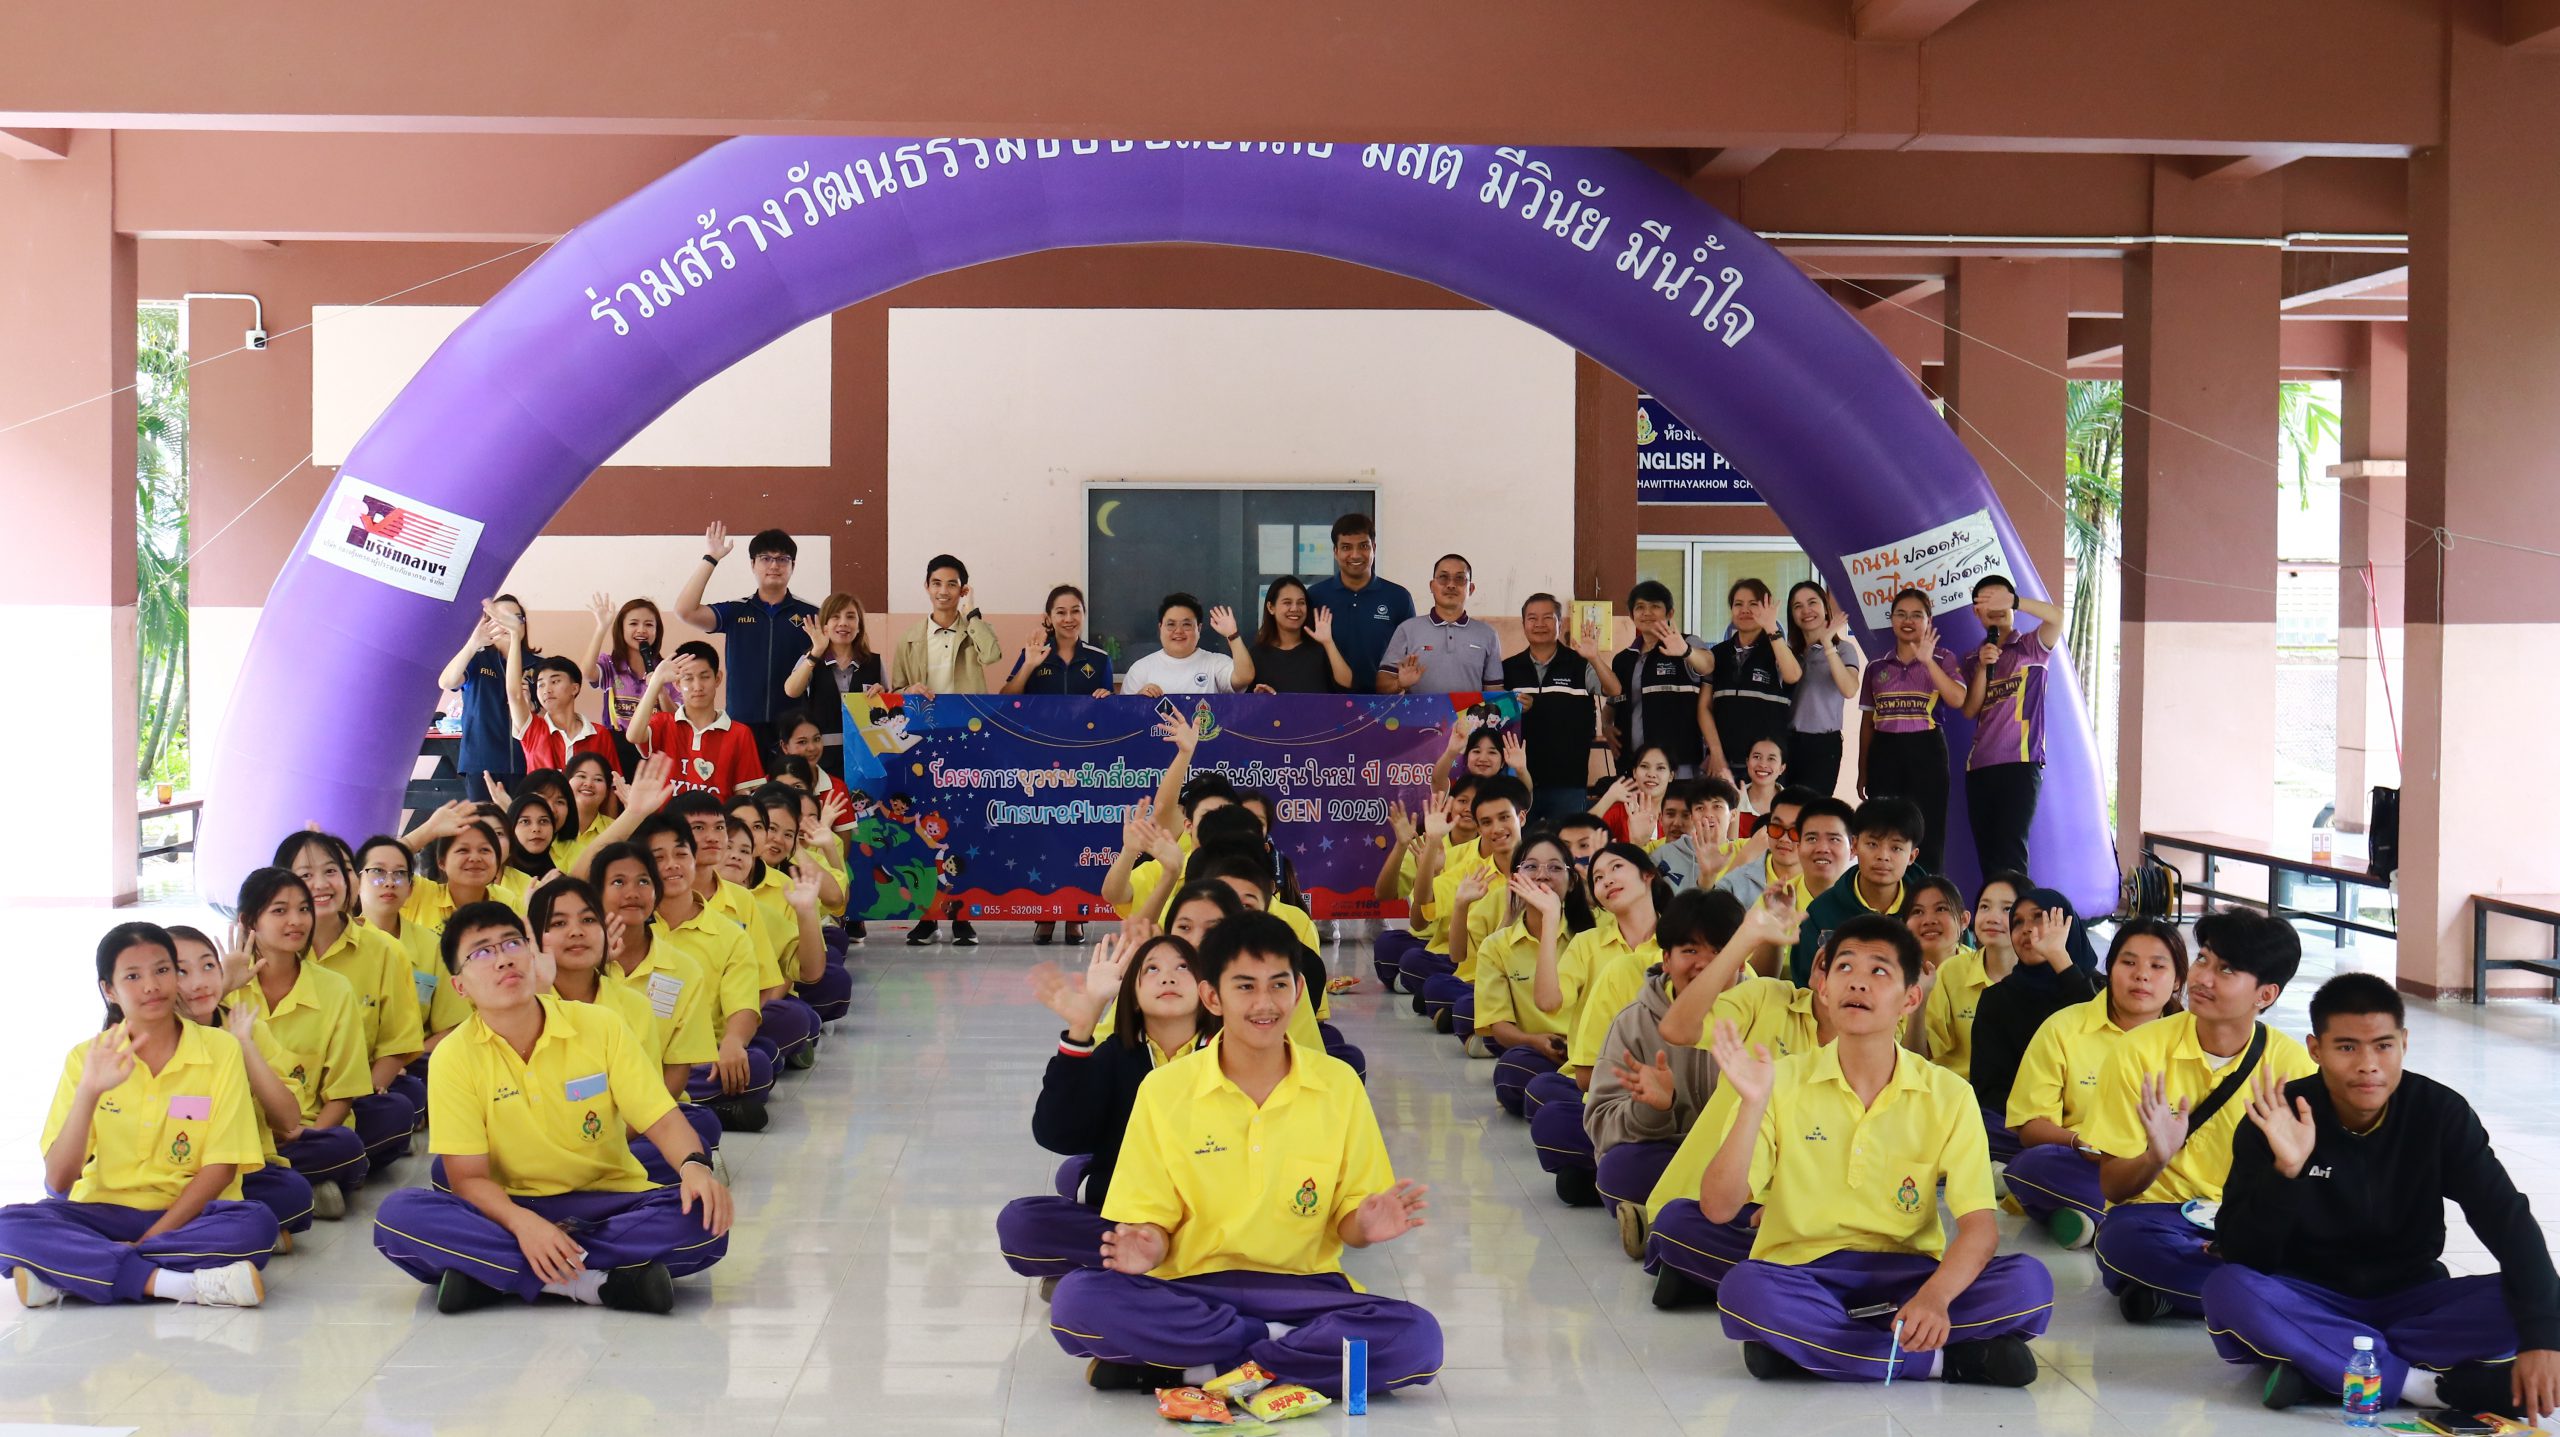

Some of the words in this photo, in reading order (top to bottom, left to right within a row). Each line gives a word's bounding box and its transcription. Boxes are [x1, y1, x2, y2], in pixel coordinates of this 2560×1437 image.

[1479, 146, 1611, 252] มีวินัย
[1616, 219, 1755, 348] มีน้ำใจ
[1663, 422, 1702, 441] ห้องเ
[1637, 452, 1706, 470] NGLISH
[1852, 547, 1900, 575] ถนน
[1903, 530, 1971, 564] ปลอดภัย
[1938, 554, 2001, 587] ปลอดภัย
[1941, 591, 1964, 605] Safe
[680, 758, 689, 775] I
[1361, 759, 1380, 786] ปี
[1276, 798, 1322, 823] GEN
[1328, 797, 1388, 825] 2025)
[983, 905, 1001, 915] 055
[1011, 904, 1042, 915] 532089
[1052, 905, 1062, 915] 91
[2309, 1165, 2332, 1178] Ari
